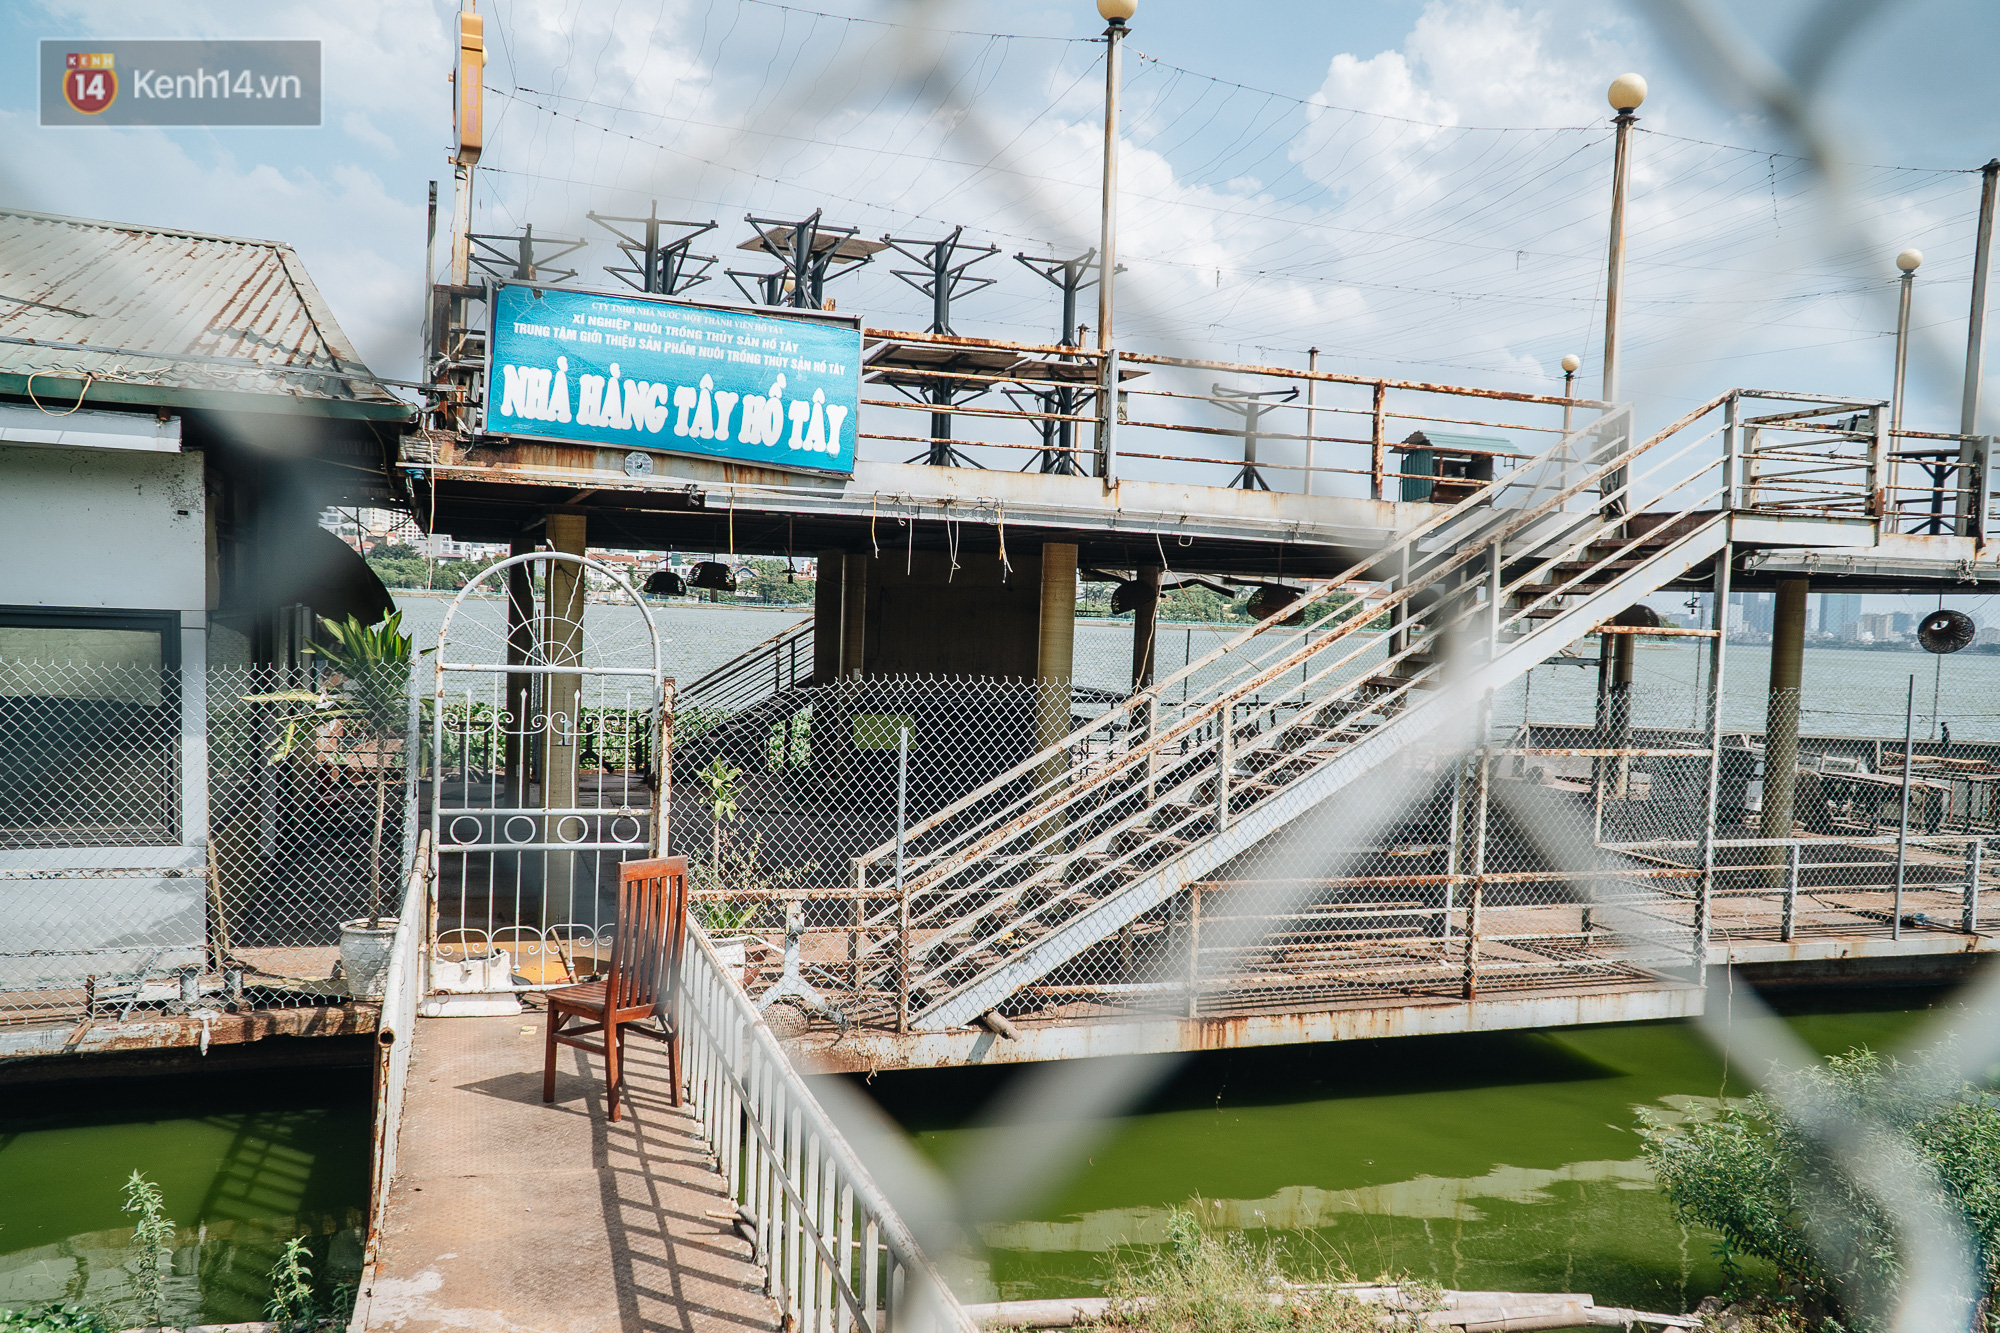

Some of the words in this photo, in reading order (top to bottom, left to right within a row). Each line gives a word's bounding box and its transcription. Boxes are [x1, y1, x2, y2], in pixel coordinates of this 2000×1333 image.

[592, 301, 610, 311] CTY
[611, 304, 635, 314] TNHH
[513, 322, 550, 338] TRUNG
[553, 325, 577, 341] TÂM
[579, 328, 603, 345] GIỚI
[605, 333, 637, 350] THIỆU
[638, 335, 661, 352] SẢN
[663, 340, 696, 357] PHẨM
[698, 345, 725, 360] NUÔI
[727, 348, 761, 365] TRỒNG
[763, 353, 789, 368] THỦY
[790, 355, 812, 372] SẢN
[828, 362, 846, 376] TÂY
[572, 313, 585, 325] XÍ
[587, 316, 631, 331] NGHIỆP
[633, 322, 662, 335] NUÔI
[665, 325, 703, 340] TRỒNG
[705, 330, 734, 344] THỦY
[736, 333, 760, 347] SẢN
[779, 340, 799, 353] TÂY
[500, 355, 572, 423] NHÀ
[576, 362, 669, 434] HÀNG
[673, 373, 739, 441] TÂY
[738, 372, 786, 447] HỒ
[788, 387, 848, 456] TÂY
